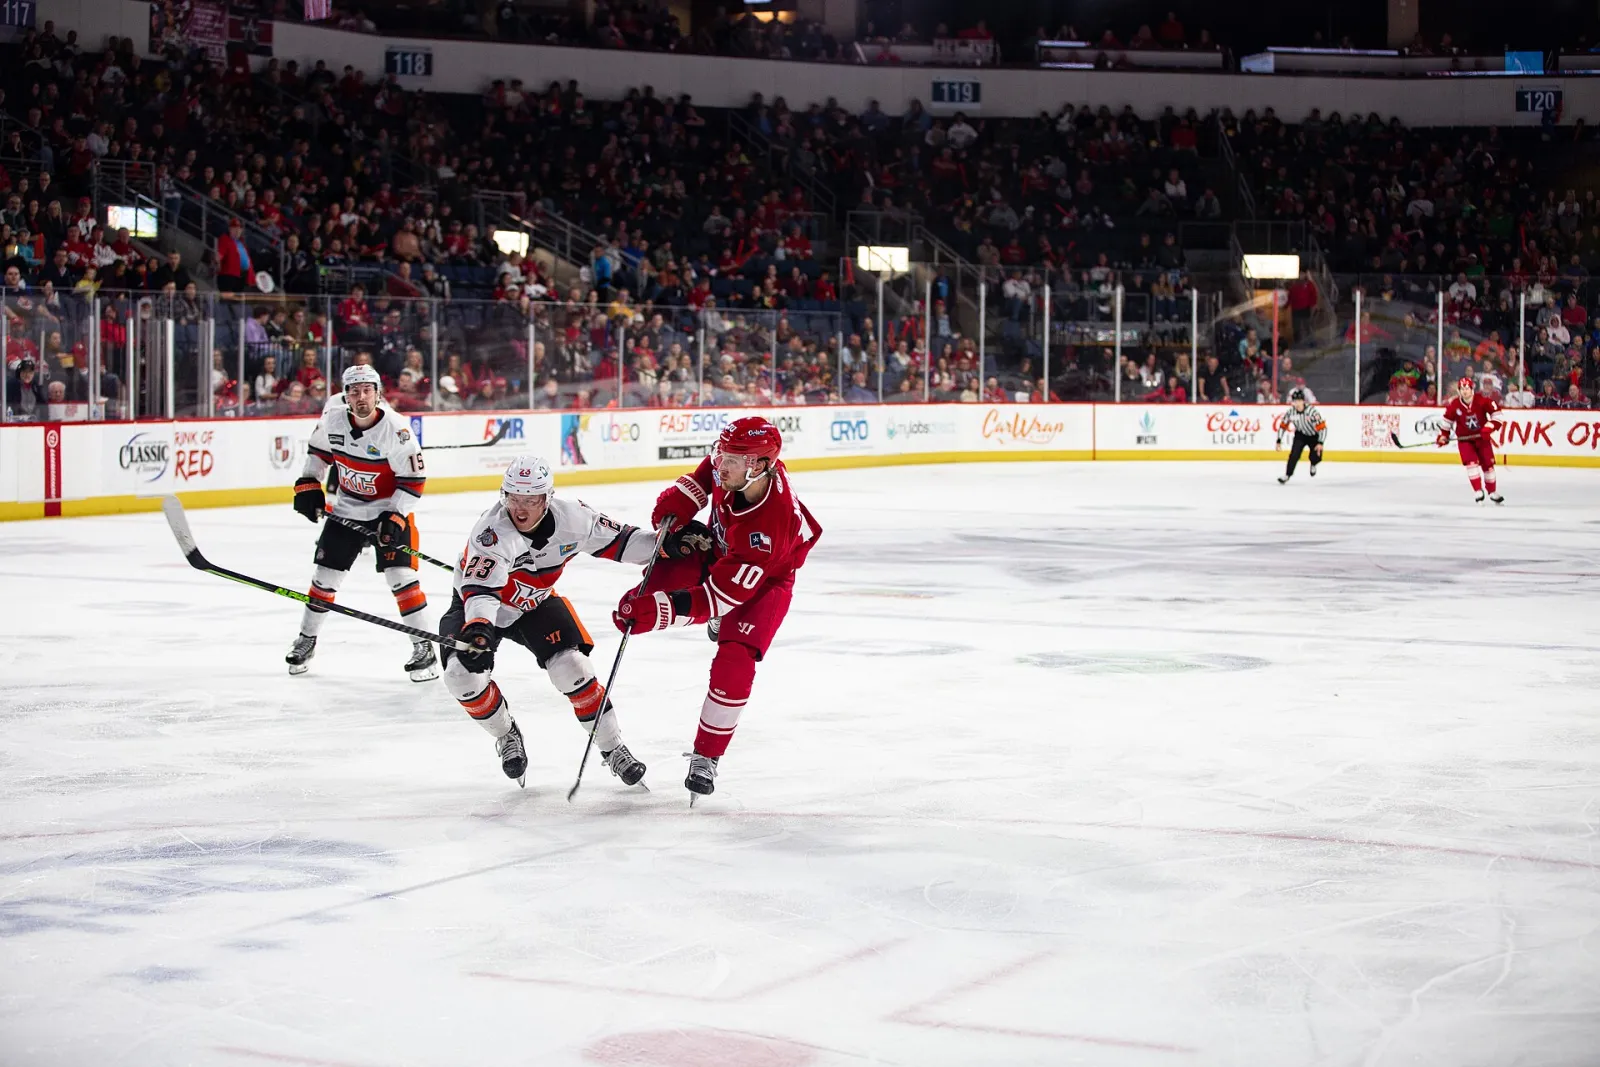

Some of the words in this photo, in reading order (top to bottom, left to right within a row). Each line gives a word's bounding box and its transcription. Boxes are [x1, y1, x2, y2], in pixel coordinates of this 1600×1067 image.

[3, 0, 30, 26] 117
[393, 52, 426, 75] 118
[940, 82, 973, 103] 119
[1524, 91, 1555, 111] 120
[600, 413, 640, 443] ubeo
[659, 413, 729, 433] FASTSIGNS
[830, 420, 868, 441] CRYO
[1202, 411, 1260, 432] Coors
[1213, 434, 1256, 445] LIGHT
[119, 444, 170, 470] CLASSIC
[175, 450, 214, 482] RED
[409, 452, 425, 473] 15
[334, 459, 381, 496] KC
[519, 468, 531, 478] 23
[598, 512, 622, 534] 2
[463, 554, 499, 581] 23
[731, 563, 764, 590] 10
[509, 578, 552, 612] K
